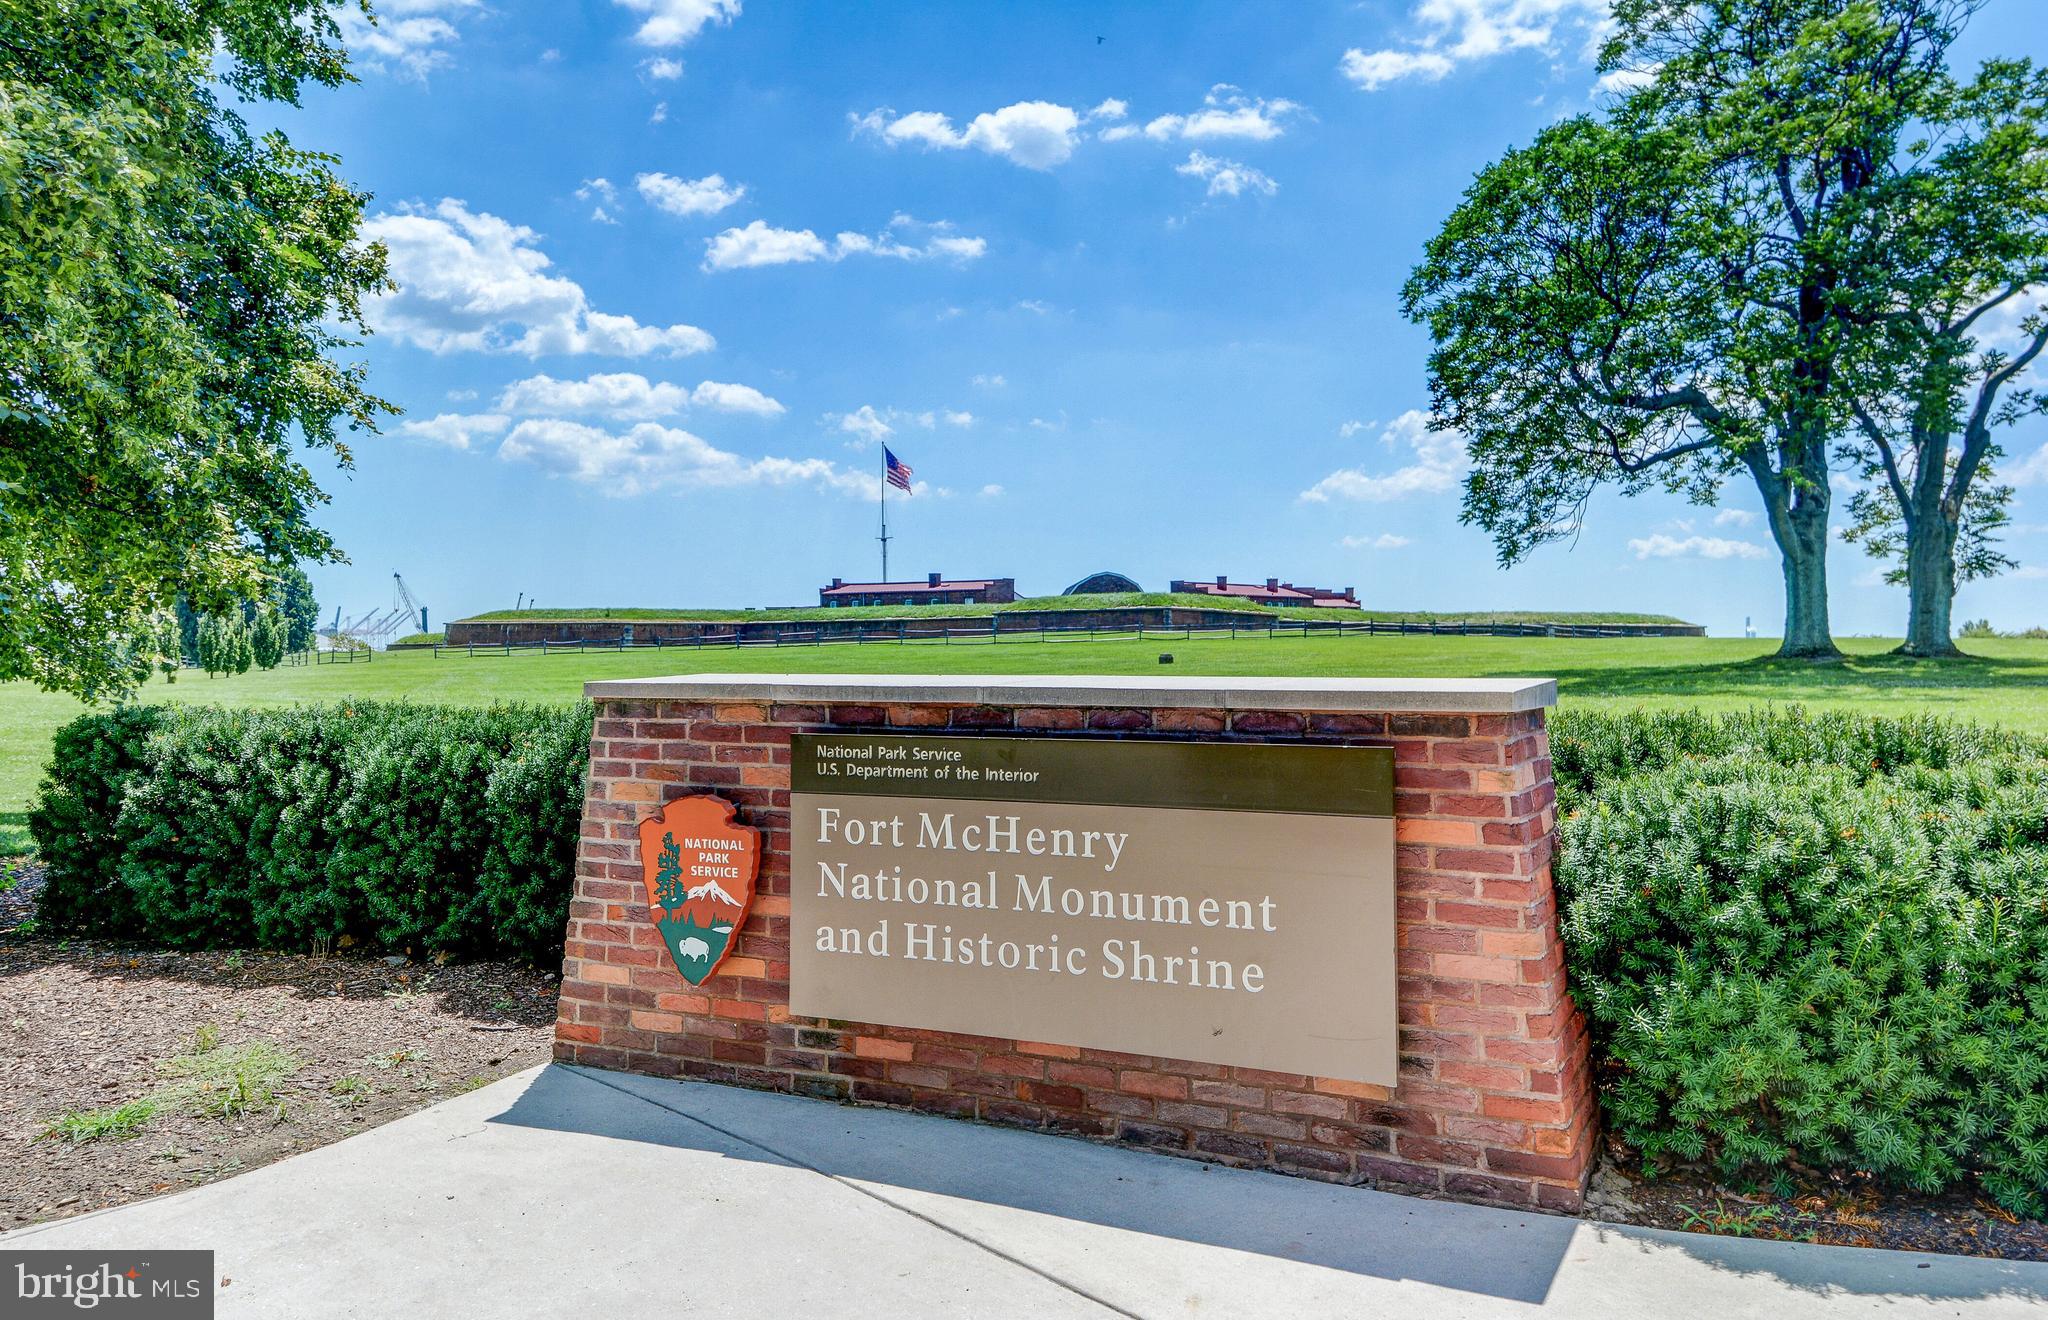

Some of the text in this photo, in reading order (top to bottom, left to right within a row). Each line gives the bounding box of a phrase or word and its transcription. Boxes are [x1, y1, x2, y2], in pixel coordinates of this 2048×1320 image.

[816, 744, 962, 762] National Park Service
[816, 763, 1040, 783] U.S. Department of the Interior
[684, 838, 745, 851] NATIONAL
[817, 808, 1129, 872] Fort McHenry
[698, 852, 730, 864] PARK
[690, 865, 739, 879] SERVICE
[816, 861, 1278, 932] National Monument
[815, 919, 1266, 994] and Historic Shrine
